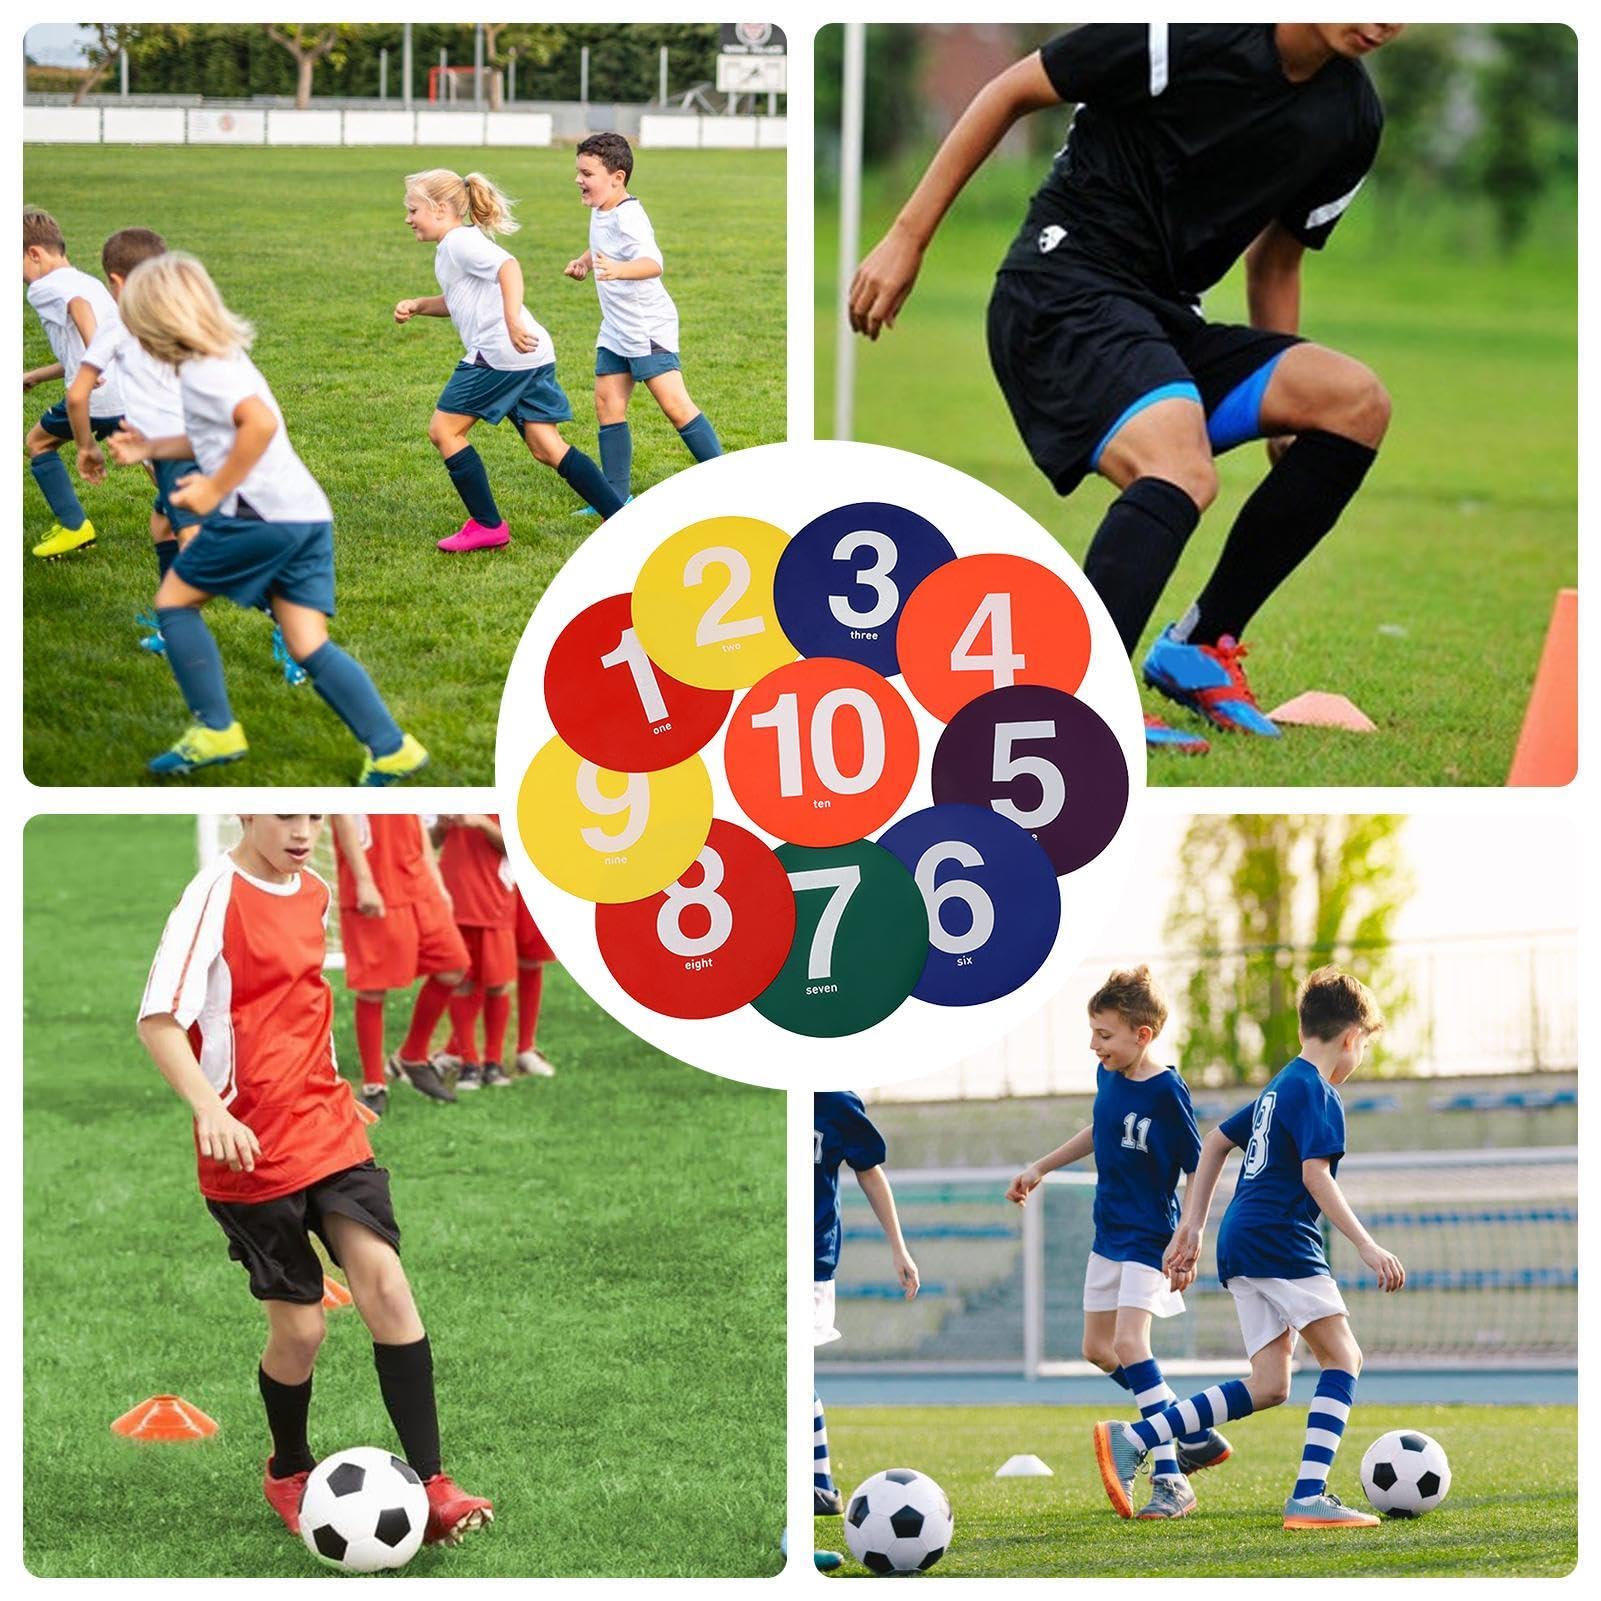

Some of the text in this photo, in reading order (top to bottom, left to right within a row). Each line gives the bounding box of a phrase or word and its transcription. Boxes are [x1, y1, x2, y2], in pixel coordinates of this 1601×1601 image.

[682, 545, 766, 647] 2
[828, 529, 900, 629] 3
[600, 626, 670, 724] 1
[720, 642, 742, 653] two
[849, 629, 879, 641] three
[950, 592, 1026, 689] 4
[652, 722, 673, 736] one
[751, 687, 886, 798] 10
[990, 719, 1067, 830] 5
[576, 758, 651, 853] 9
[812, 798, 832, 810] ten
[603, 854, 628, 866] nine
[656, 844, 733, 957] 8
[913, 840, 995, 955] 6
[684, 957, 714, 972] eight
[786, 865, 862, 980] 7
[956, 954, 974, 967] six
[804, 983, 839, 996] seven
[1120, 1111, 1152, 1153] 11
[1243, 1091, 1277, 1180] 8
